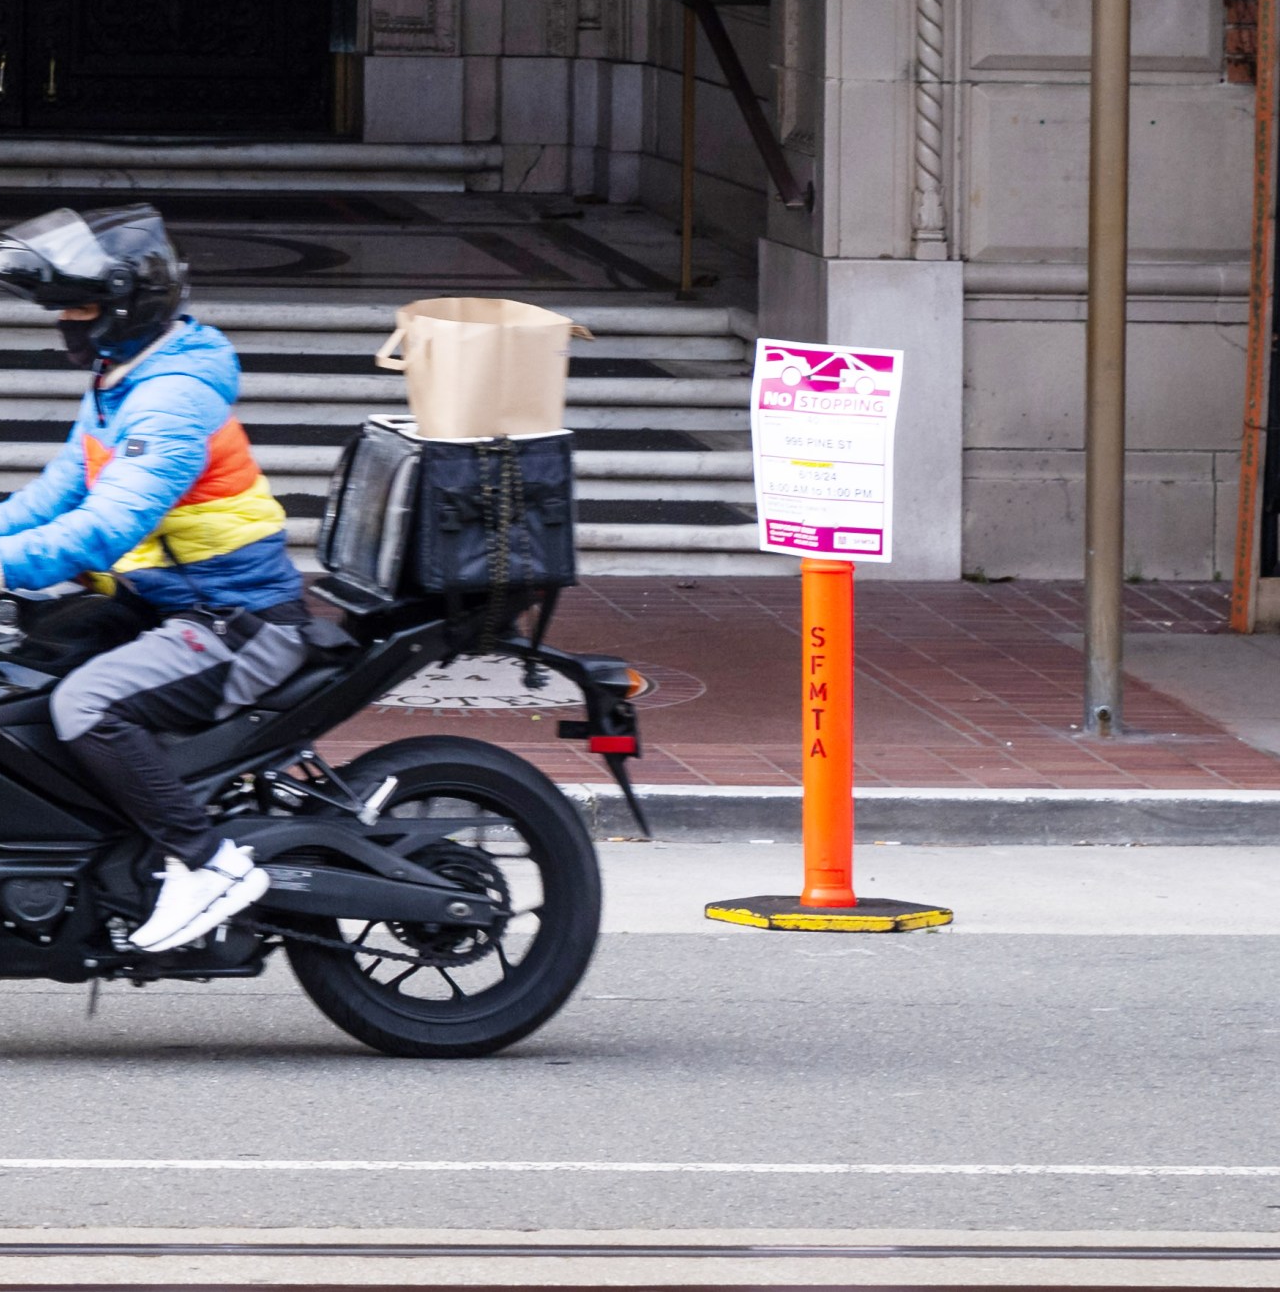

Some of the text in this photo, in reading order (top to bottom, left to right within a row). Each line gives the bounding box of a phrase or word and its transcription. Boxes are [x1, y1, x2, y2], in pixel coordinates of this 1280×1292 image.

[763, 390, 885, 413] NO STOPPING
[807, 437, 833, 449] PINE
[838, 439, 853, 450] ST
[793, 484, 809, 494] AM
[826, 486, 851, 498] 1:00
[854, 488, 873, 499] PM
[809, 626, 828, 759] SFMTA
